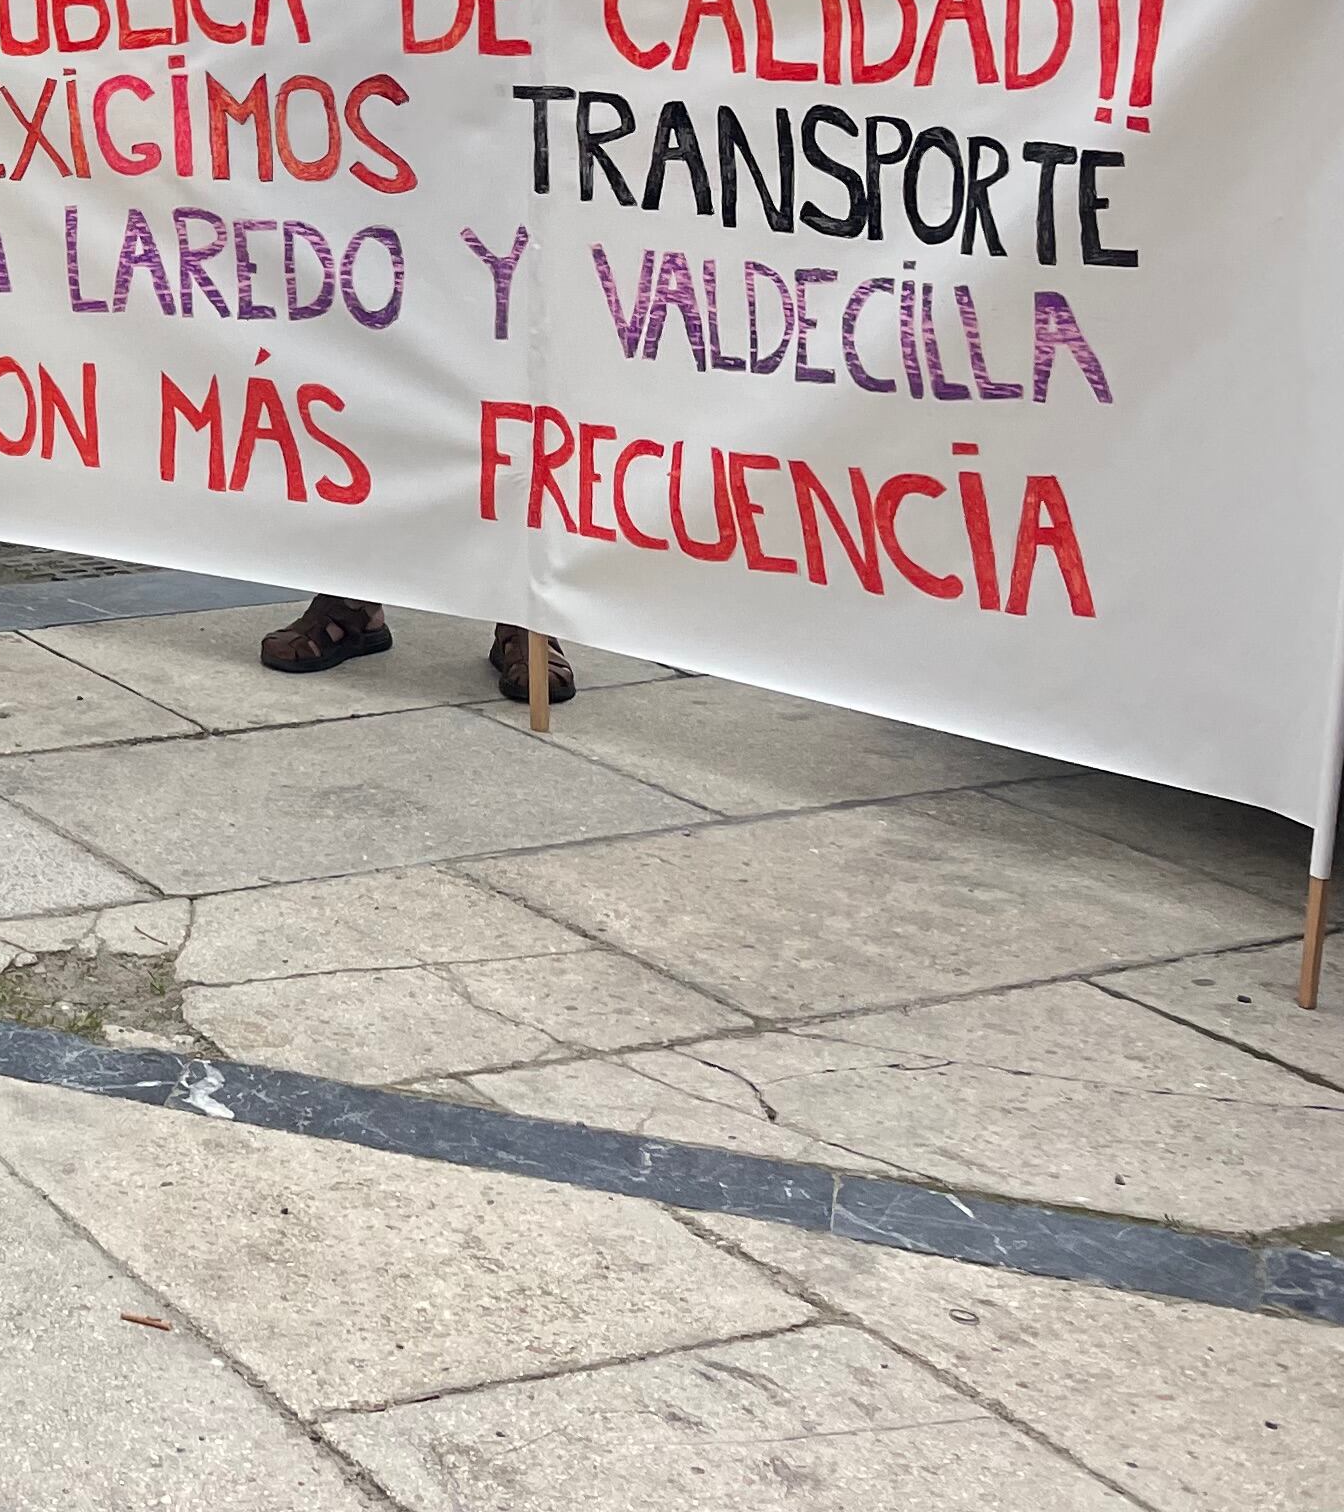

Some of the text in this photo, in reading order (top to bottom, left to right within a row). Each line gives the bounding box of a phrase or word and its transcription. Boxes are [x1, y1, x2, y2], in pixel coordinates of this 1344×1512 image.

[511, 85, 1140, 269] TRANSPORTE
[64, 204, 405, 330] LAREDO
[459, 224, 529, 341] Y
[589, 243, 1114, 404] VALDECILLA
[159, 346, 373, 506] MÁS
[479, 400, 1097, 620] FRECUENCIA
